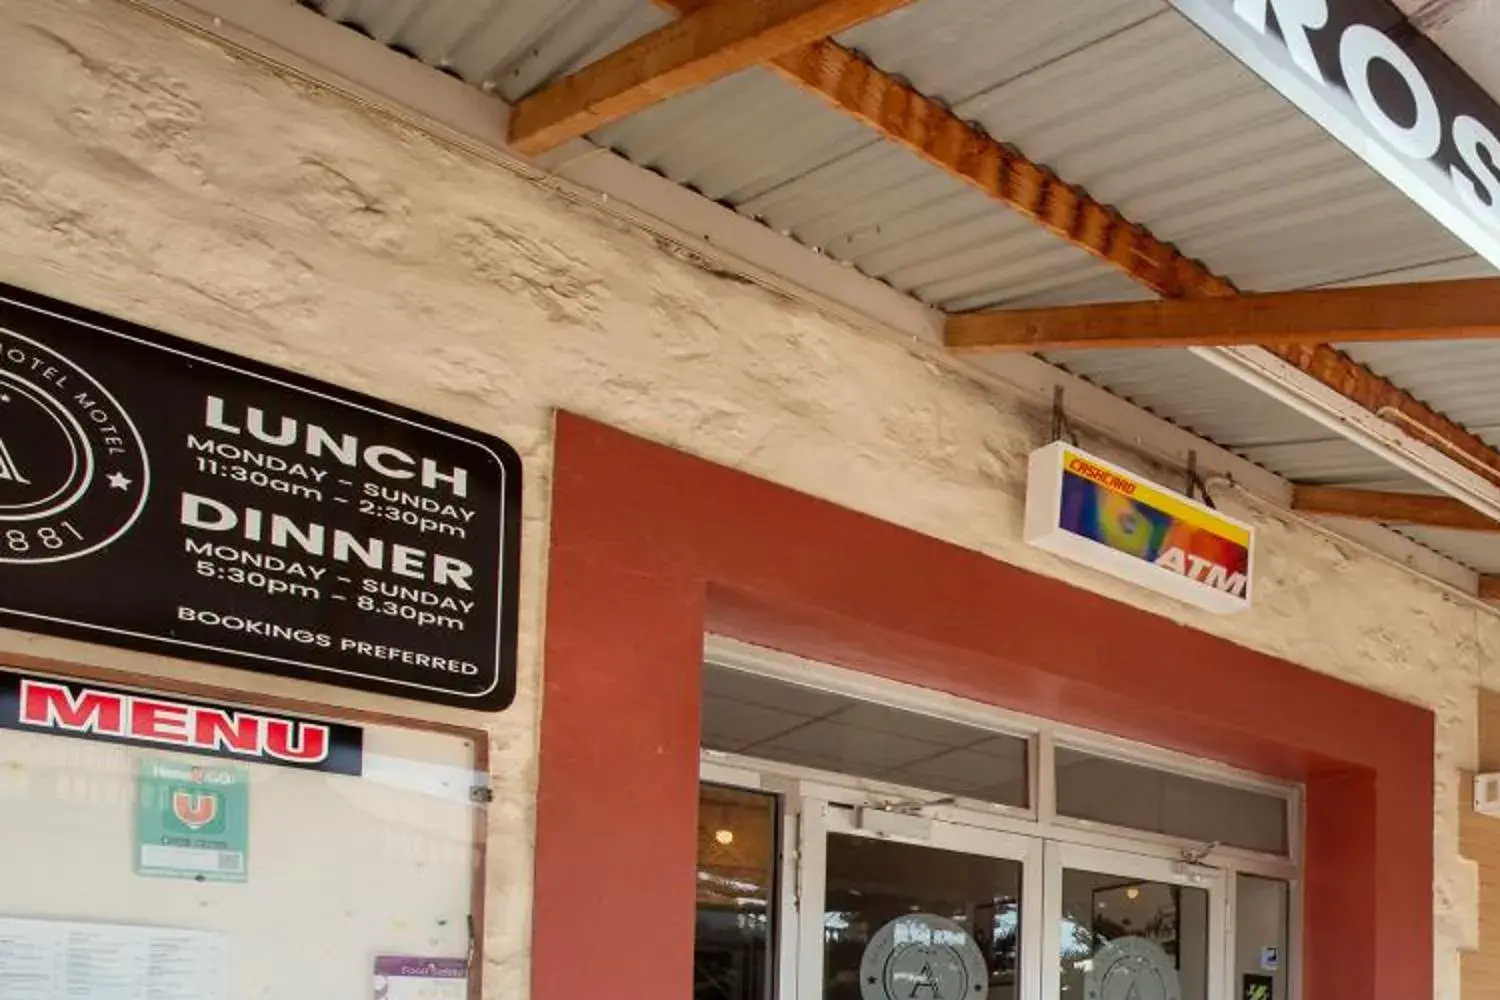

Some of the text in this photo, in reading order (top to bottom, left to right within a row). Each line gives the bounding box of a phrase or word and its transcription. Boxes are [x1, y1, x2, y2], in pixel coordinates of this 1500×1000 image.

[0, 343, 126, 456] OTEL MOTEL
[186, 434, 328, 484] MONDAY
[364, 483, 476, 524] SUNDAY
[205, 395, 469, 498] LUNCH
[196, 457, 323, 503] 11:30am
[358, 500, 466, 539] 2:30pm
[181, 492, 474, 592] DINNER
[185, 538, 328, 581] MONDAY
[363, 578, 475, 616] SUNDAY
[196, 561, 321, 601] 5:30pm
[1154, 546, 1248, 599] ATM
[177, 606, 479, 676] BOOKINGS PREFERRED
[19, 679, 329, 764] MENU
